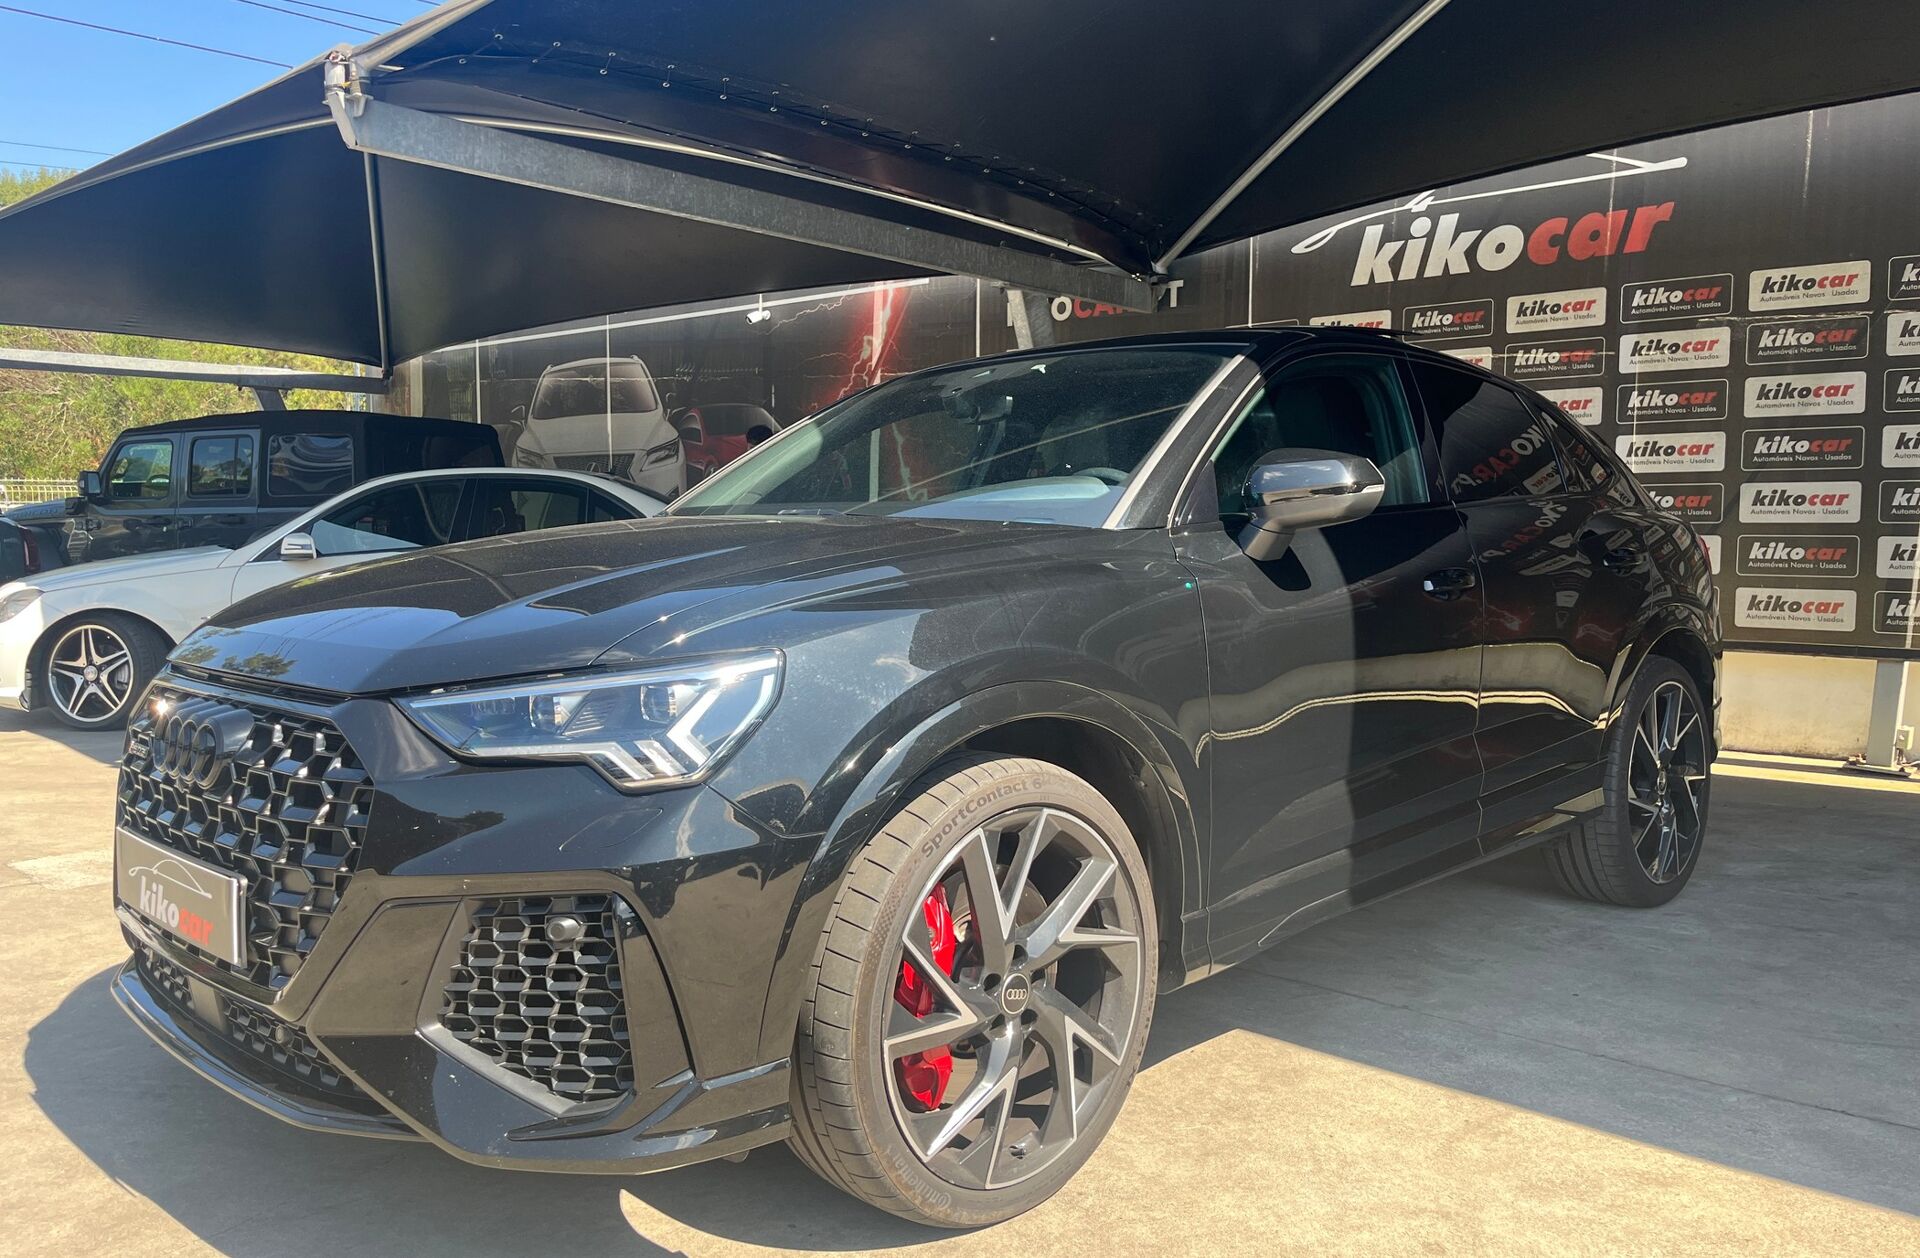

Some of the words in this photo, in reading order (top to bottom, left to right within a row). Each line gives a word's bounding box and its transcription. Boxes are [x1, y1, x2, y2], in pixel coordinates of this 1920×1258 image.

[1350, 202, 1675, 287] kikocar
[1761, 273, 1859, 294] kikocar
[1632, 286, 1722, 307] kikocar
[1516, 299, 1597, 318] kikocar
[1412, 309, 1485, 328] kikocar
[1758, 328, 1857, 347] kikocar
[1630, 338, 1719, 357] kikocar
[1830, 344, 1857, 352] Usados
[1515, 348, 1596, 366] kikocar
[1628, 390, 1718, 407] kikocar
[1756, 383, 1855, 400] kikocar
[1626, 441, 1715, 457] kikocar
[1754, 436, 1853, 454] kikocar
[1825, 453, 1852, 461] Usados
[1752, 490, 1850, 506] kikocar
[1822, 507, 1849, 515] Usados
[1749, 542, 1847, 560] kikocar
[1747, 594, 1844, 614] kikocar
[921, 780, 1028, 858] SportContact
[139, 876, 213, 945] kikocar
